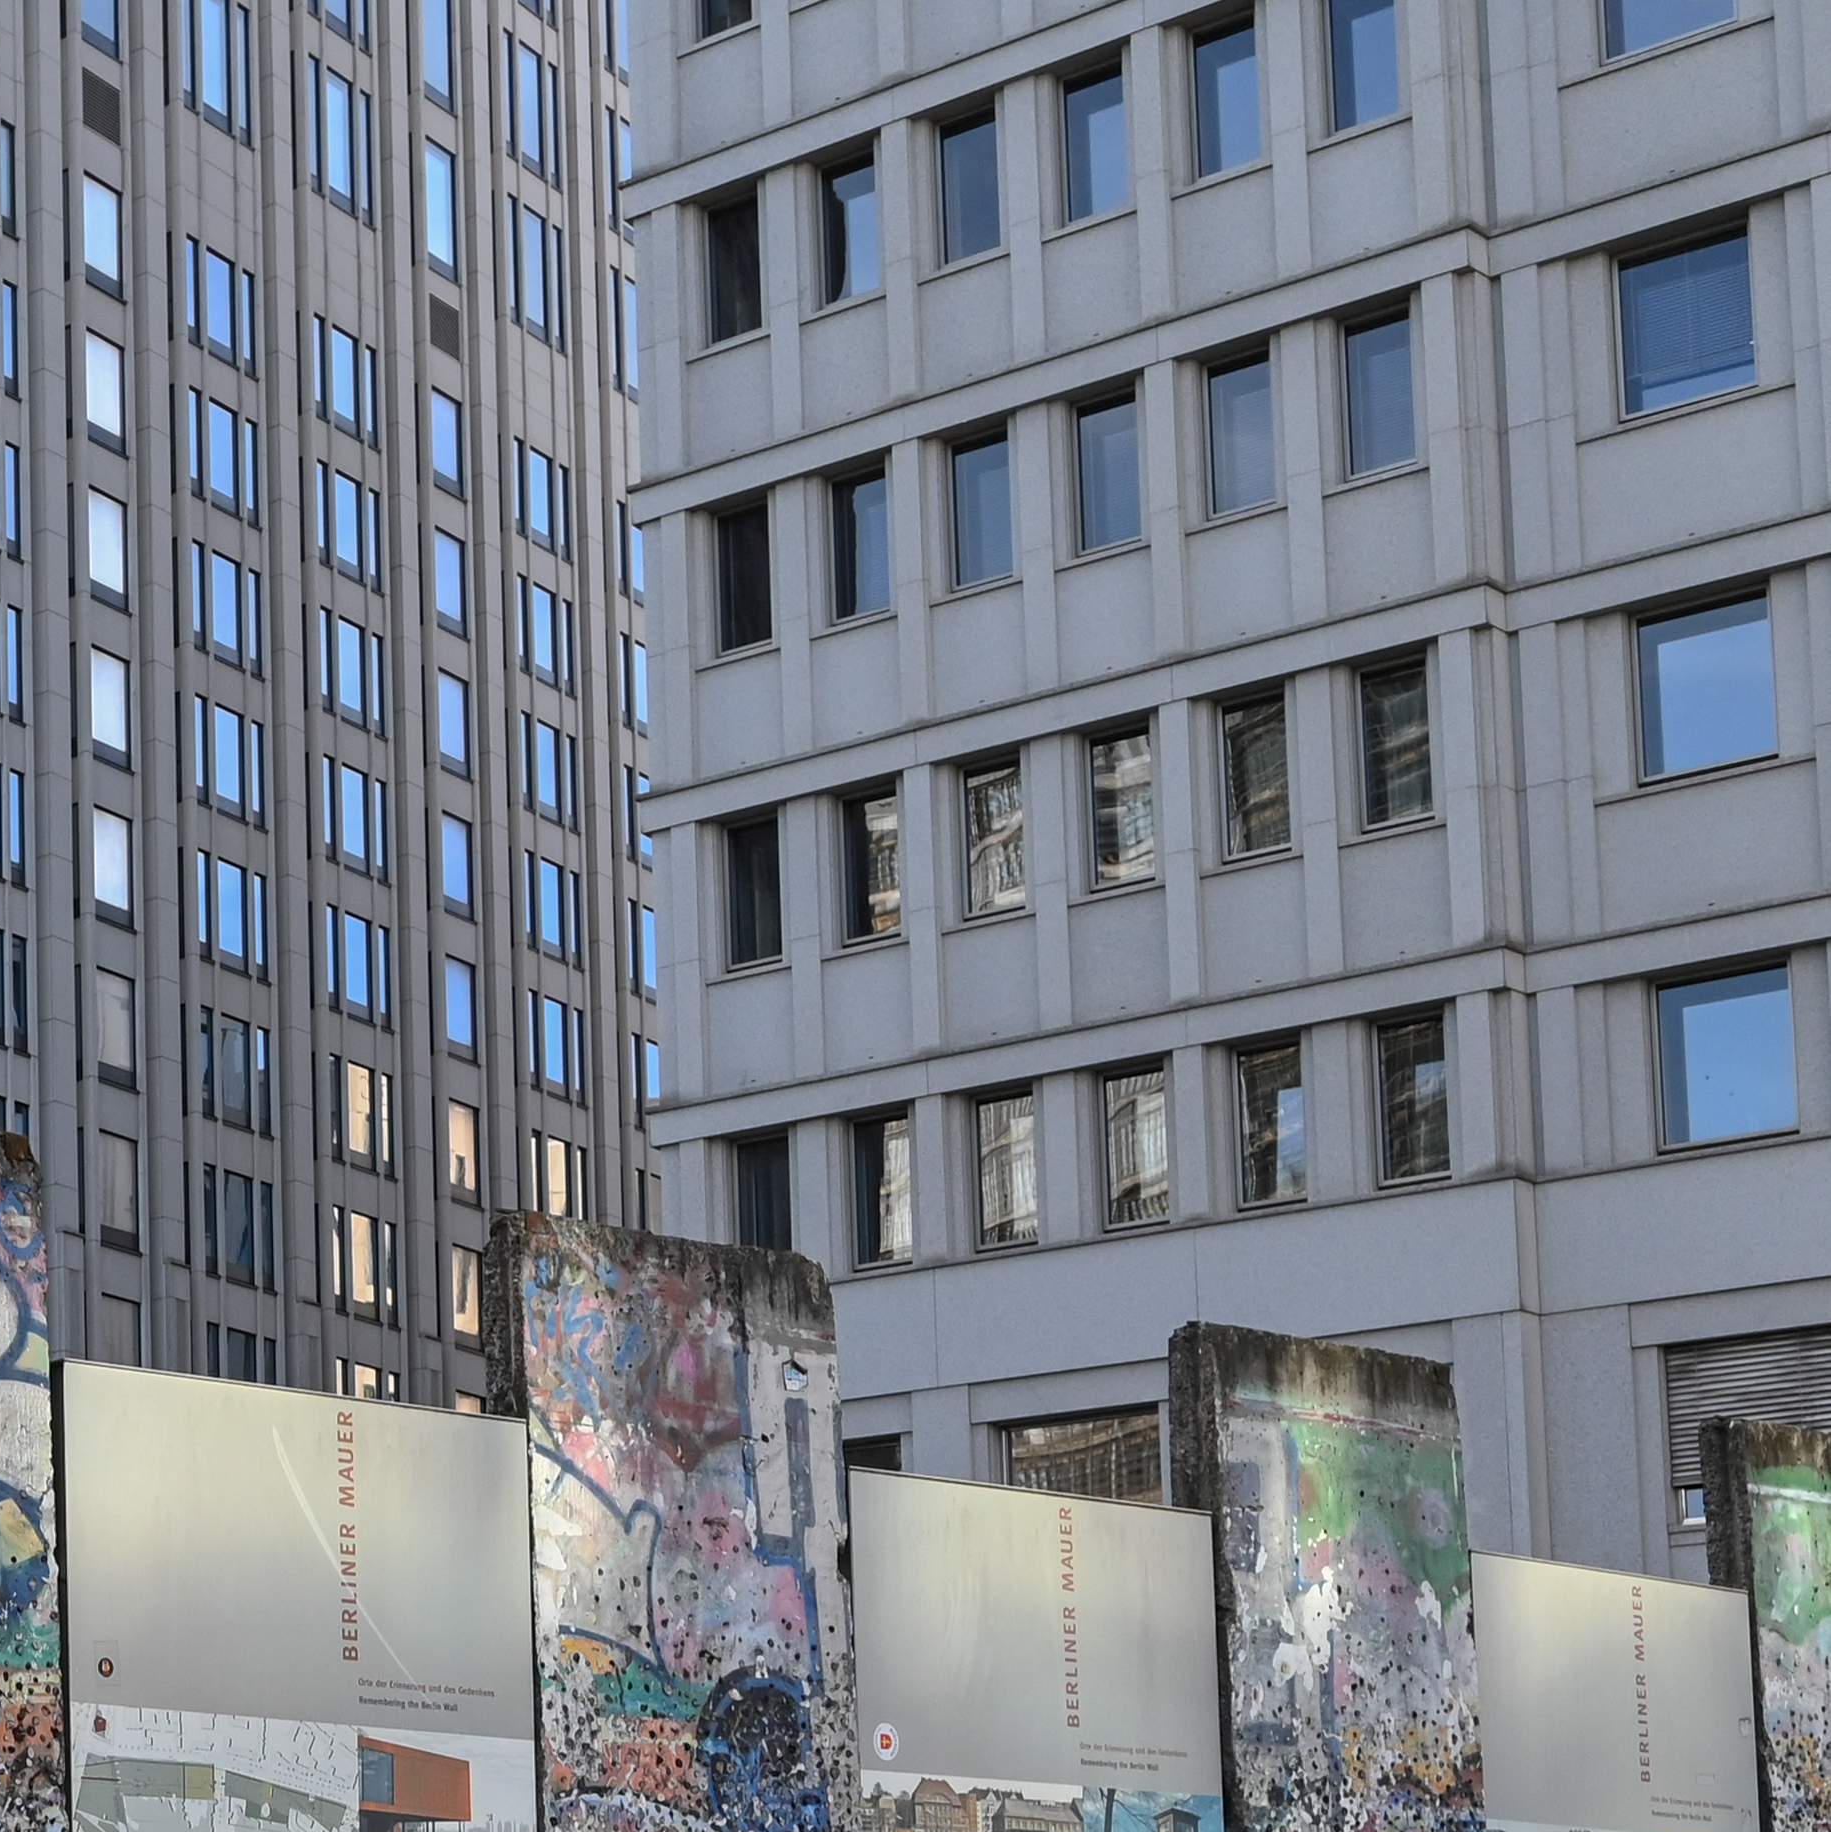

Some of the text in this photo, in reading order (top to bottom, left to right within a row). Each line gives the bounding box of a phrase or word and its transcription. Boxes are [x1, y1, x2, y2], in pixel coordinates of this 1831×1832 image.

[337, 1411, 358, 1661] BERLINER MAUER
[1059, 1506, 1080, 1728] BERLINER MAUER
[358, 1696, 405, 1709] Remembering
[1632, 1586, 1650, 1783] BERLINER MAUER
